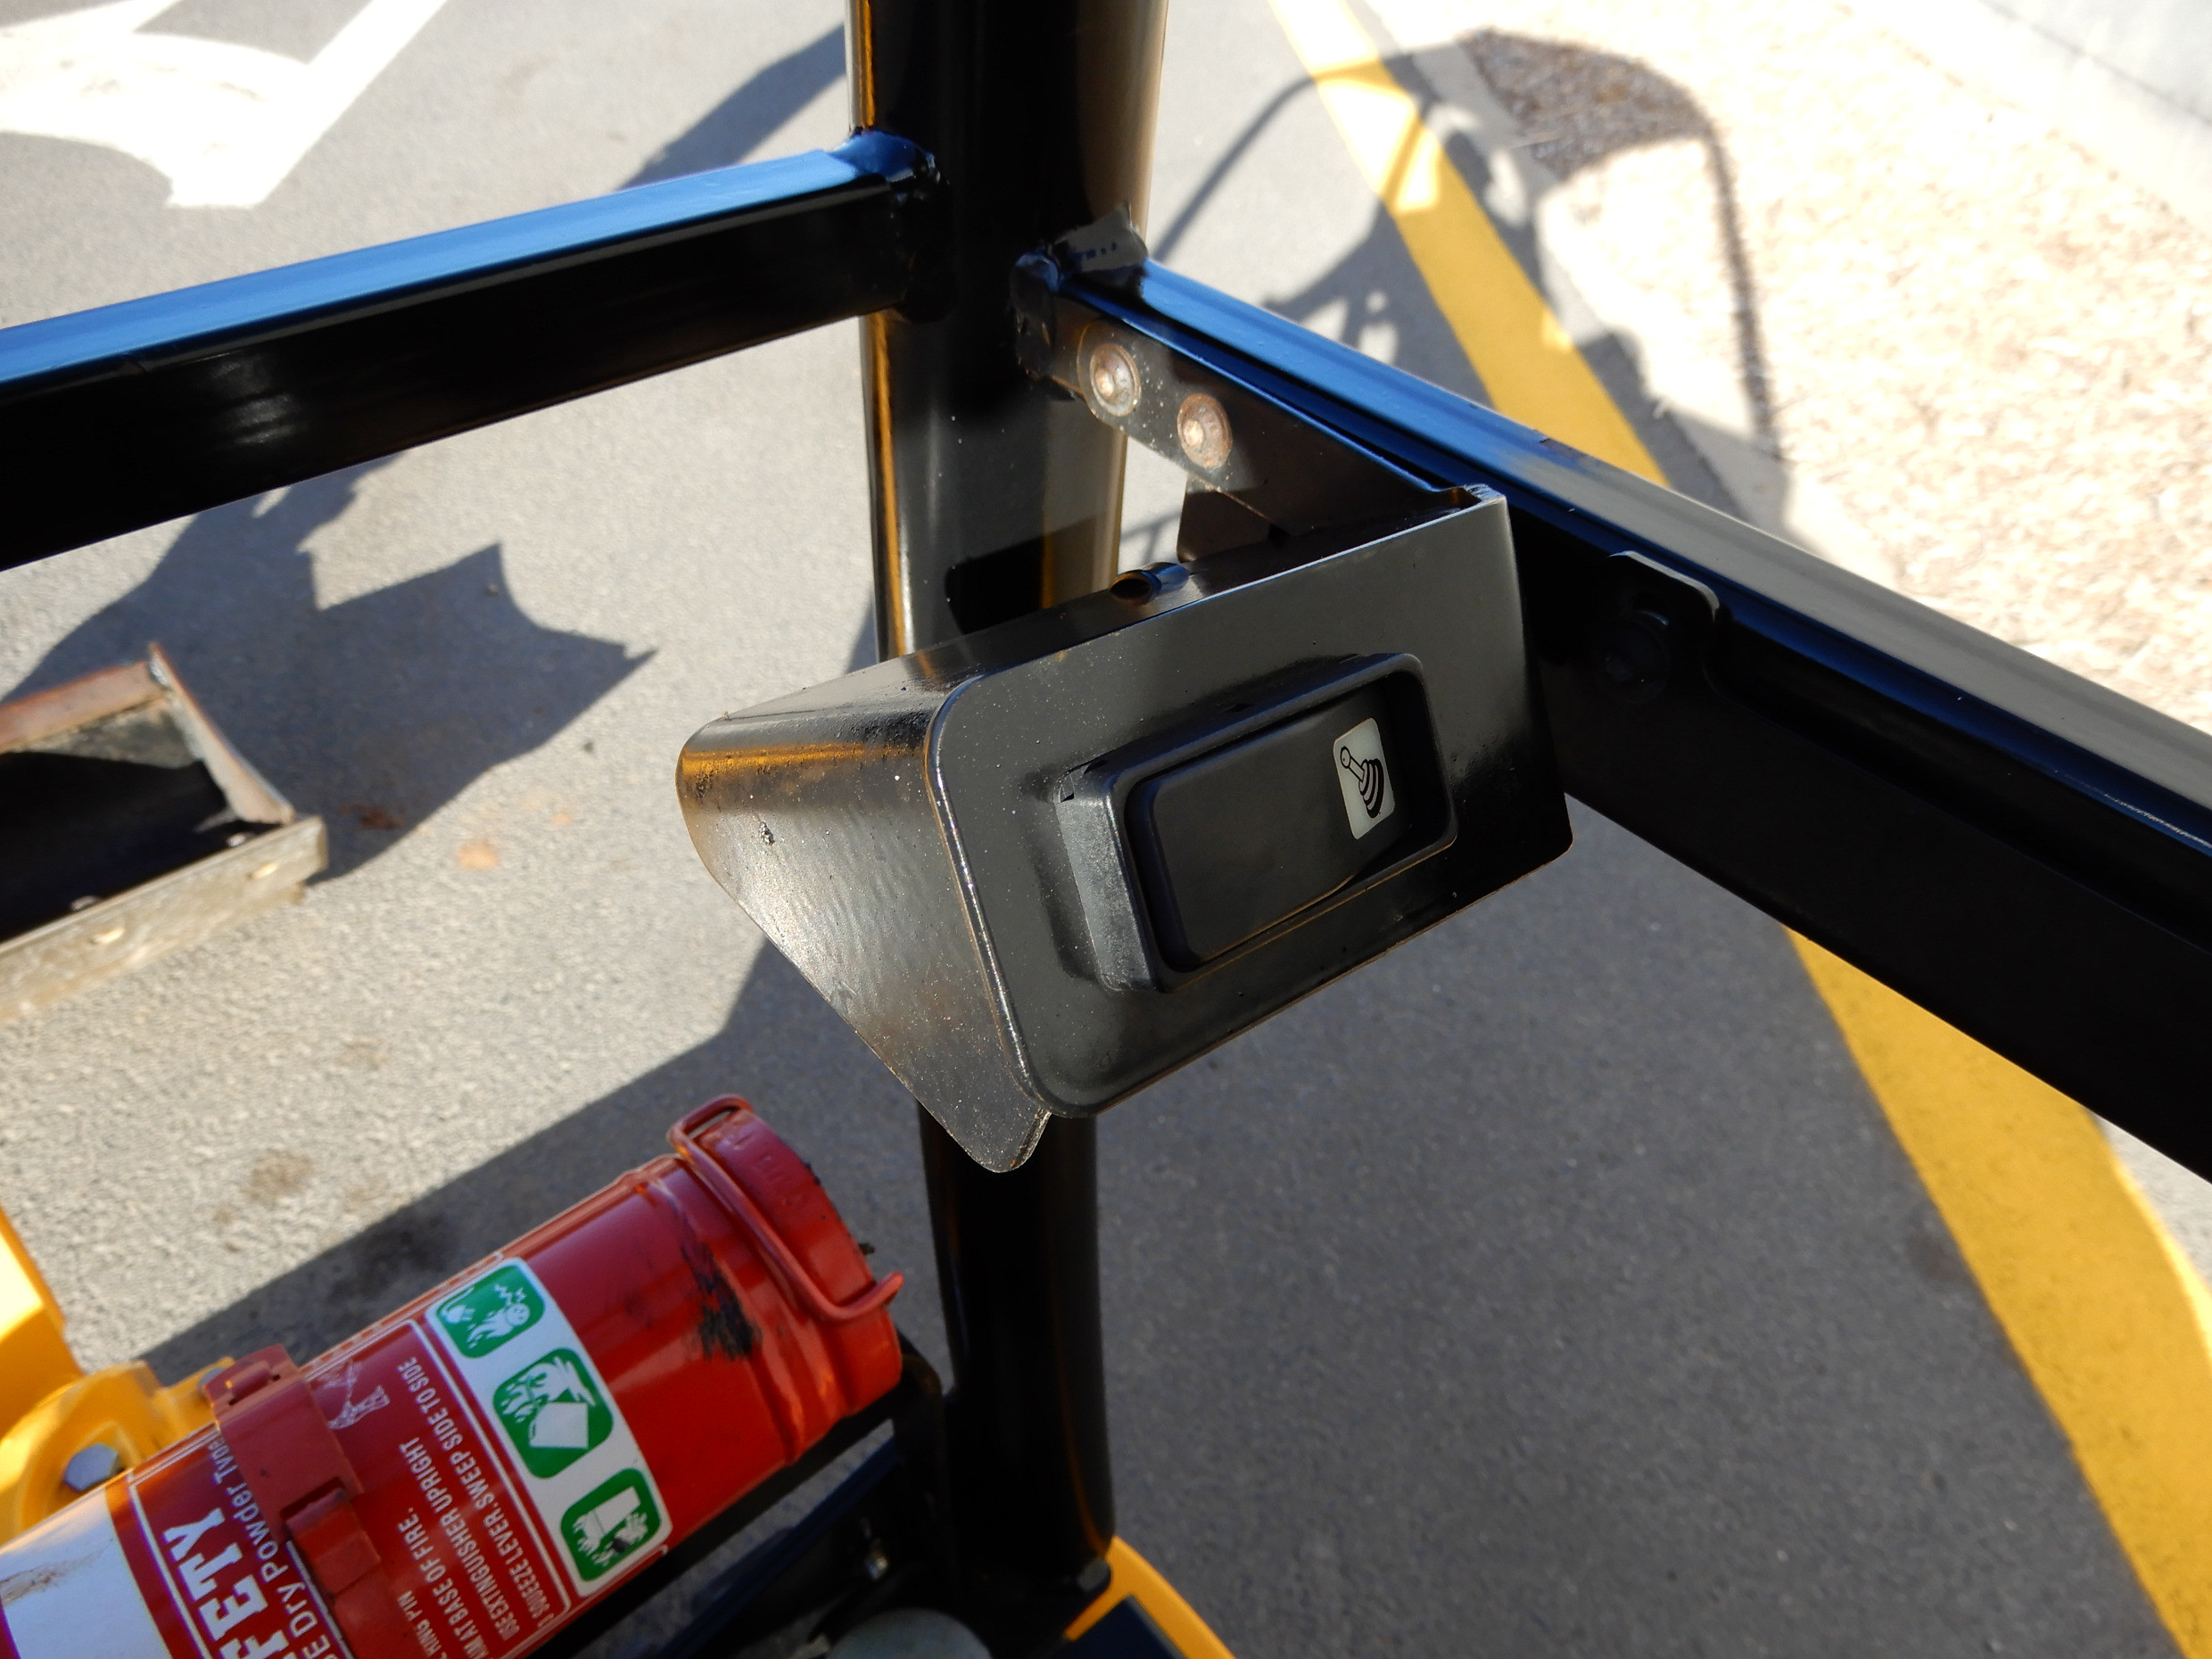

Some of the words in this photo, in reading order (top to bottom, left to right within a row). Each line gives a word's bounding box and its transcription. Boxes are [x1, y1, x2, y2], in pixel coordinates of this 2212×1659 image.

[397, 1357, 430, 1392] SIDE
[416, 1387, 441, 1414] TO
[426, 1407, 463, 1450] SIDE
[399, 1437, 453, 1513] UPRIGHT
[226, 1482, 289, 1583] Powder
[398, 1507, 434, 1561] FIRE.
[163, 1507, 297, 1659] FETY
[419, 1557, 447, 1583] OF
[439, 1507, 509, 1620] EXTINGUISHER
[508, 1558, 550, 1618] SQUEEZE
[276, 1581, 318, 1638] Dry
[397, 1589, 423, 1622] PIN
[432, 1578, 468, 1626] BASE
[453, 1619, 479, 1641] AT
